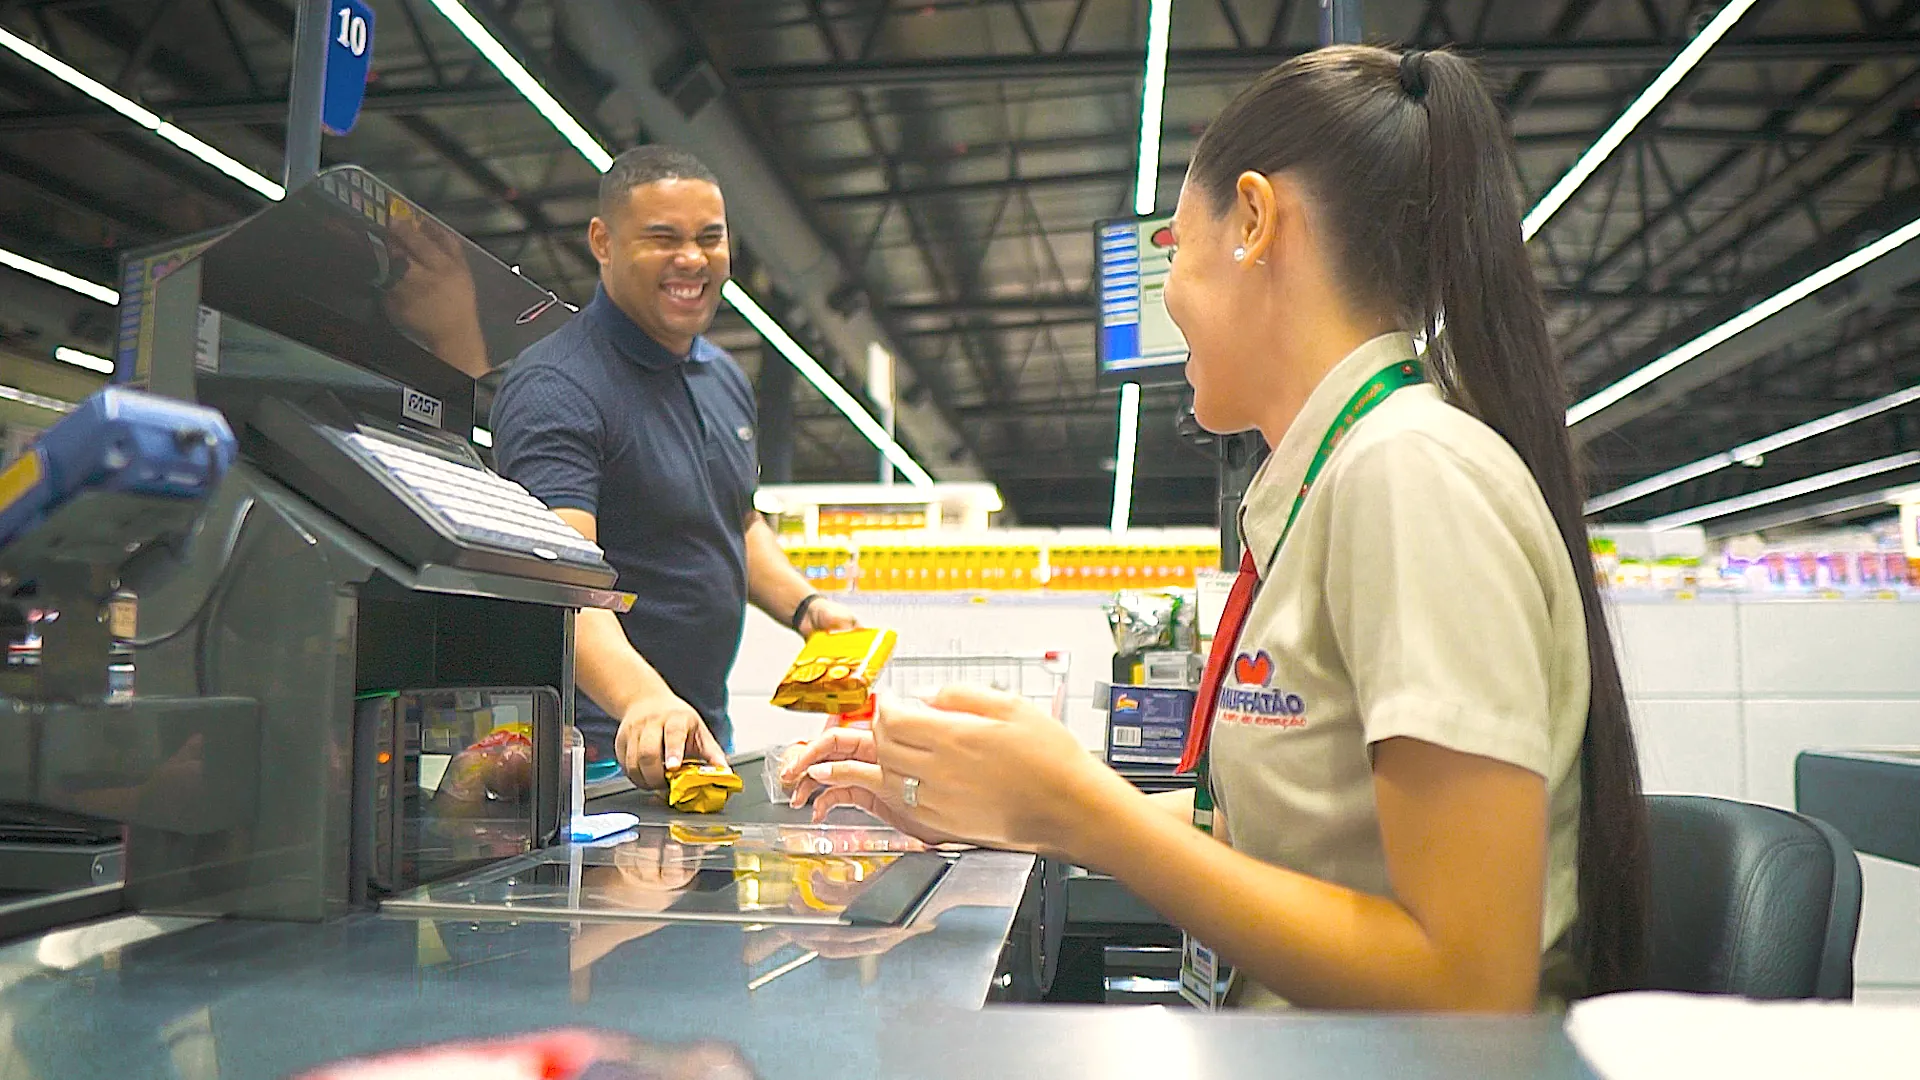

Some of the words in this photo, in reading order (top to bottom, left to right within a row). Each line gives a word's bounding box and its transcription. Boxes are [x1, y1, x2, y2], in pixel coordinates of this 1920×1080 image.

[337, 7, 367, 56] 10
[408, 393, 439, 416] FAST
[1220, 688, 1305, 715] MUFFATÃO
